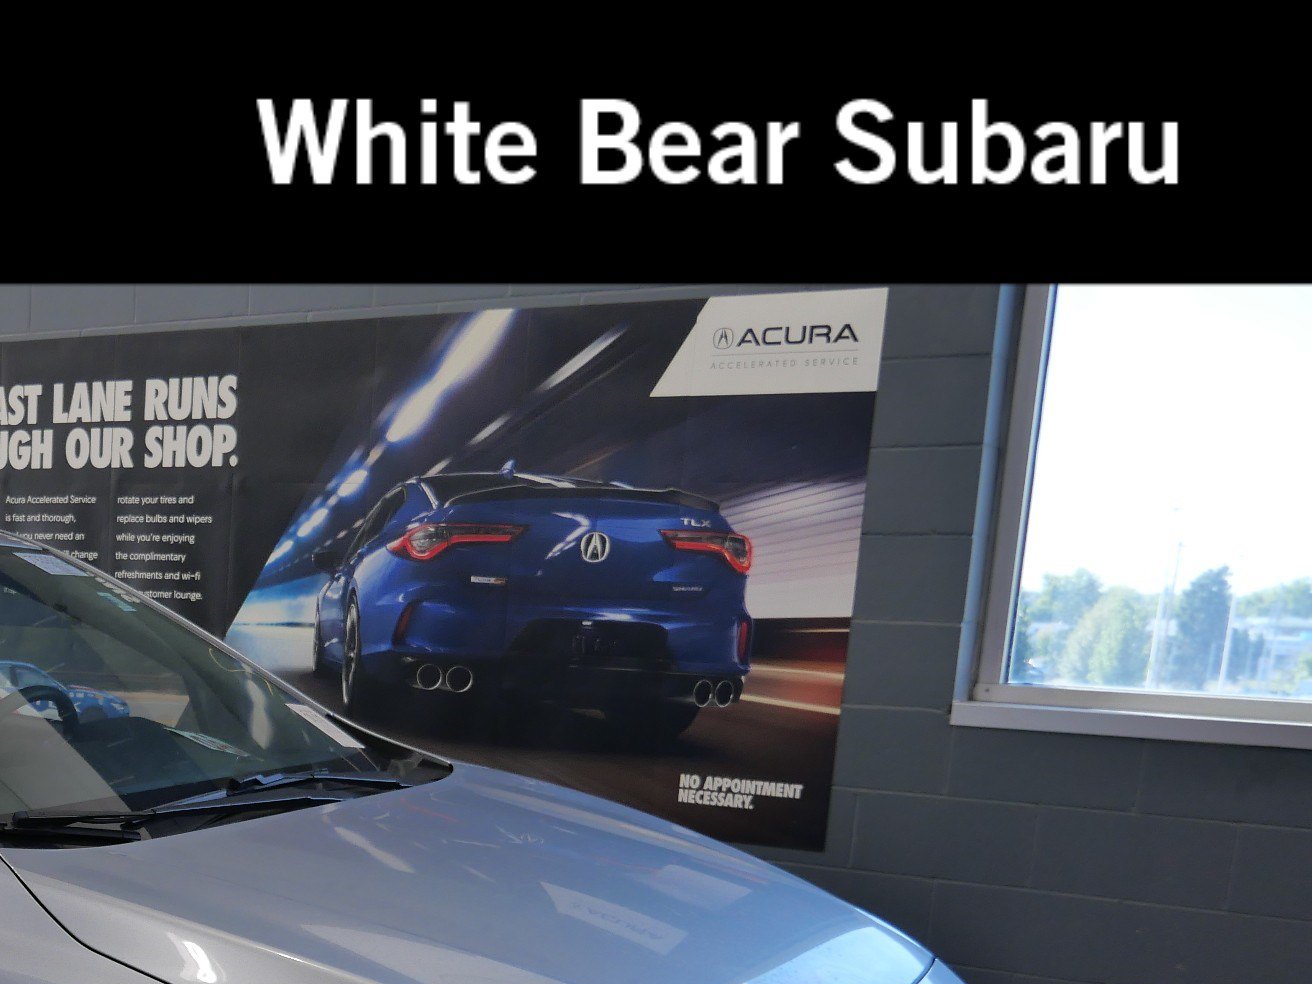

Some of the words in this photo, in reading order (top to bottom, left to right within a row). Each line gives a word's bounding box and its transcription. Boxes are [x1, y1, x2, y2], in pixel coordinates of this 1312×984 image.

[736, 324, 859, 347] ACURA
[710, 360, 796, 370] ACCELERATED
[804, 357, 859, 367] SERVICE
[52, 380, 133, 424] LANE
[144, 375, 238, 421] RUNS
[65, 427, 134, 469] OUR
[144, 424, 238, 468] SHOP.
[5, 495, 25, 504] Acura
[26, 495, 69, 504] Accelerated
[69, 495, 96, 504] Service
[117, 495, 140, 504] rotate
[141, 496, 158, 506] your
[159, 495, 177, 504] tires
[178, 495, 195, 504] and
[5, 513, 12, 522] is
[12, 513, 25, 522] fast
[26, 513, 41, 522] and
[41, 513, 76, 524] thorough,
[116, 514, 144, 525] replace
[145, 514, 167, 523] bulbs
[168, 514, 185, 523] and
[186, 514, 213, 525] wipers
[680, 517, 711, 528] TLX
[34, 532, 53, 541] never
[54, 531, 73, 541] need
[74, 532, 85, 541] an
[115, 533, 135, 542] while
[136, 533, 160, 543] you're
[161, 533, 195, 545] enjoying
[70, 550, 98, 560] change
[115, 551, 128, 560] the
[129, 551, 186, 563] complimentary
[114, 570, 163, 580] refreshments
[164, 571, 179, 580] and
[181, 571, 201, 581] wi-fi
[173, 590, 203, 602] lounge.
[679, 773, 700, 789] NO
[703, 775, 804, 799] APPOINTMENT
[677, 788, 755, 810] NECESSARY.
